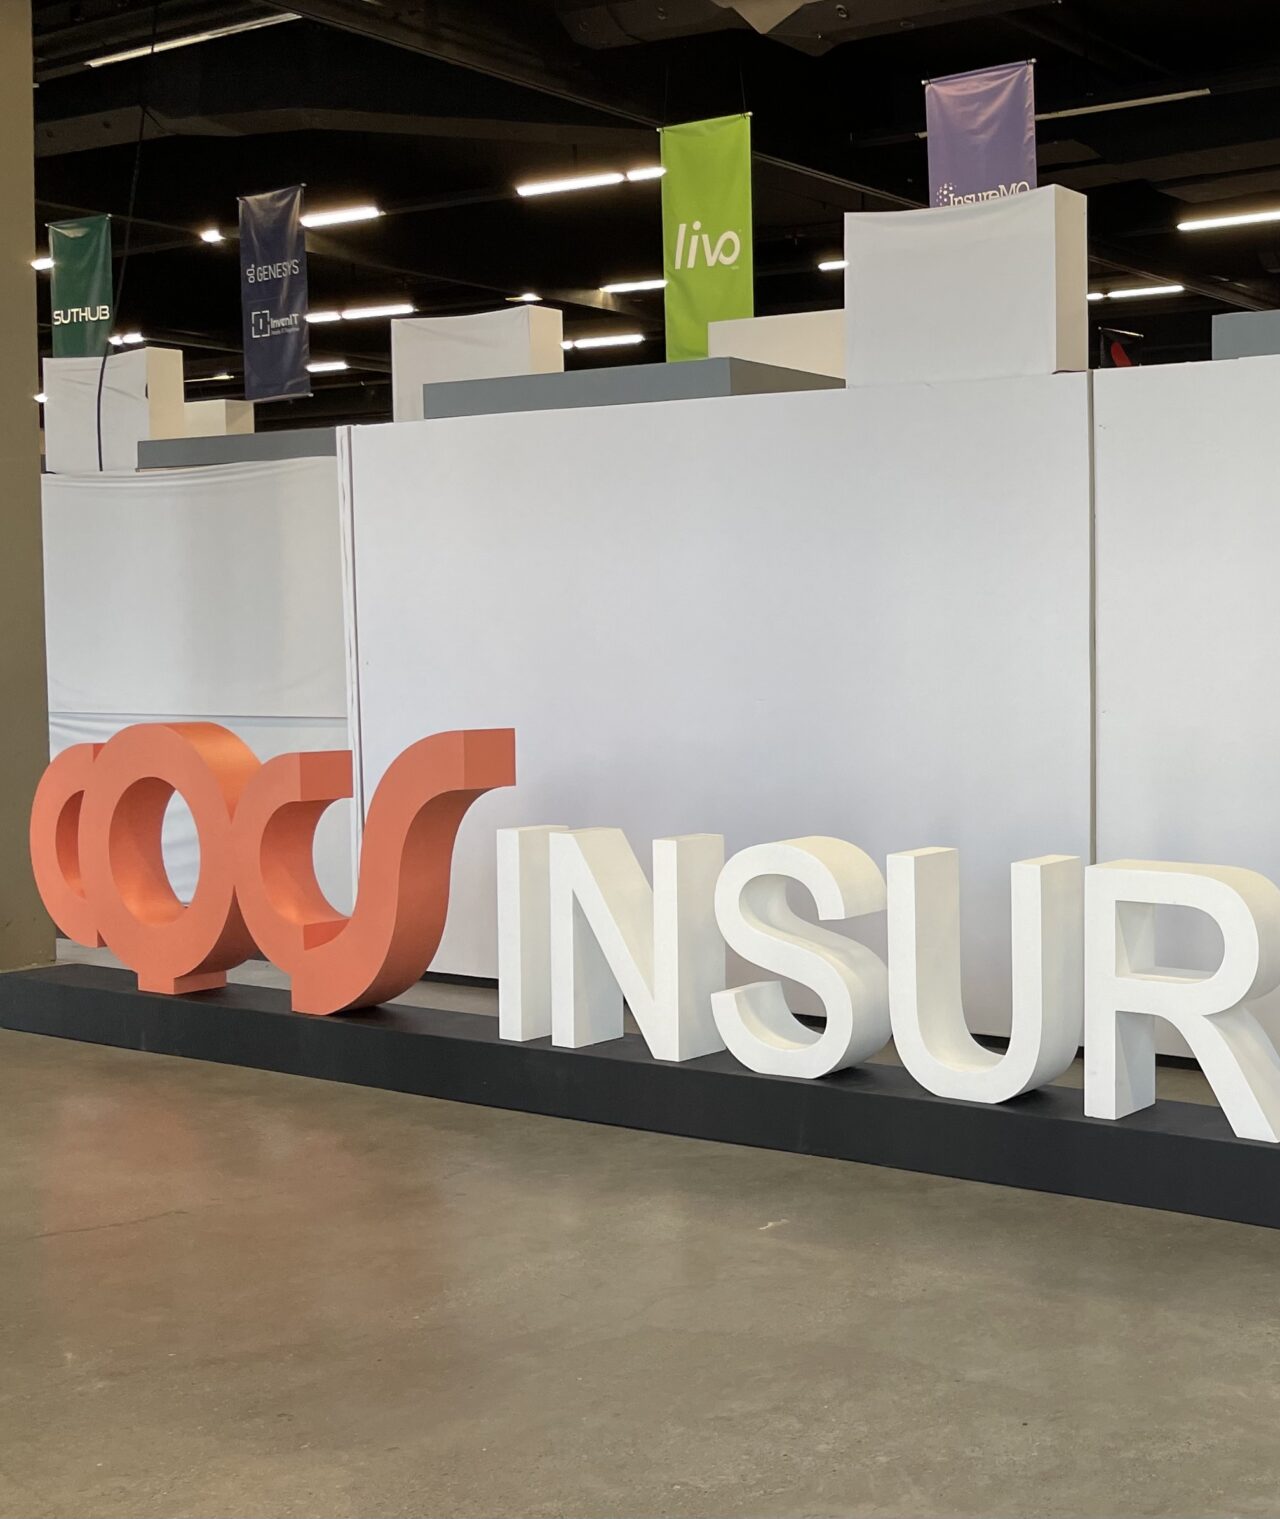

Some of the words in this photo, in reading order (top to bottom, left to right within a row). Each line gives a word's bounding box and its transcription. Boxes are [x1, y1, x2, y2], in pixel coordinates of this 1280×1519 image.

[674, 220, 741, 270] livo
[256, 259, 300, 282] GENESYS
[53, 305, 110, 325] SUTHUB
